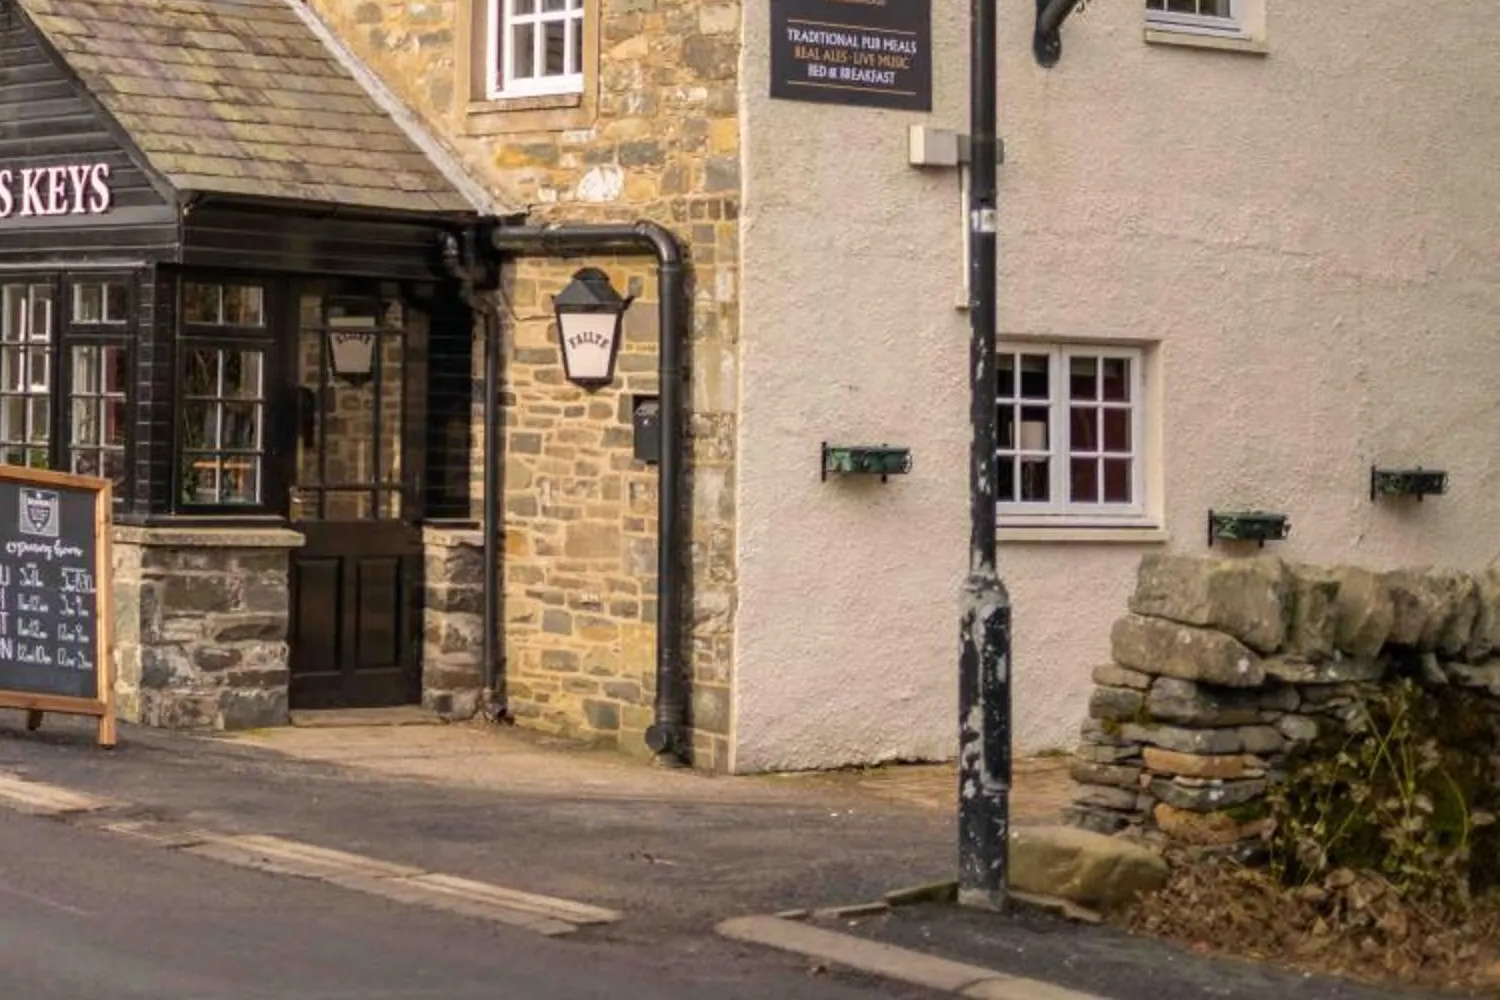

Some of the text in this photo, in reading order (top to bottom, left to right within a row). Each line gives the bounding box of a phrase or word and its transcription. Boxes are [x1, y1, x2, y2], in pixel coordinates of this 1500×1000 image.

[787, 28, 917, 53] TRADITIONAL PUB MEALS
[794, 45, 820, 60] REAL
[853, 52, 876, 67] LIVE
[878, 55, 910, 69] MUSIC
[808, 64, 827, 79] BED
[839, 68, 896, 85] BREAKFAST
[18, 163, 110, 216] KEYS
